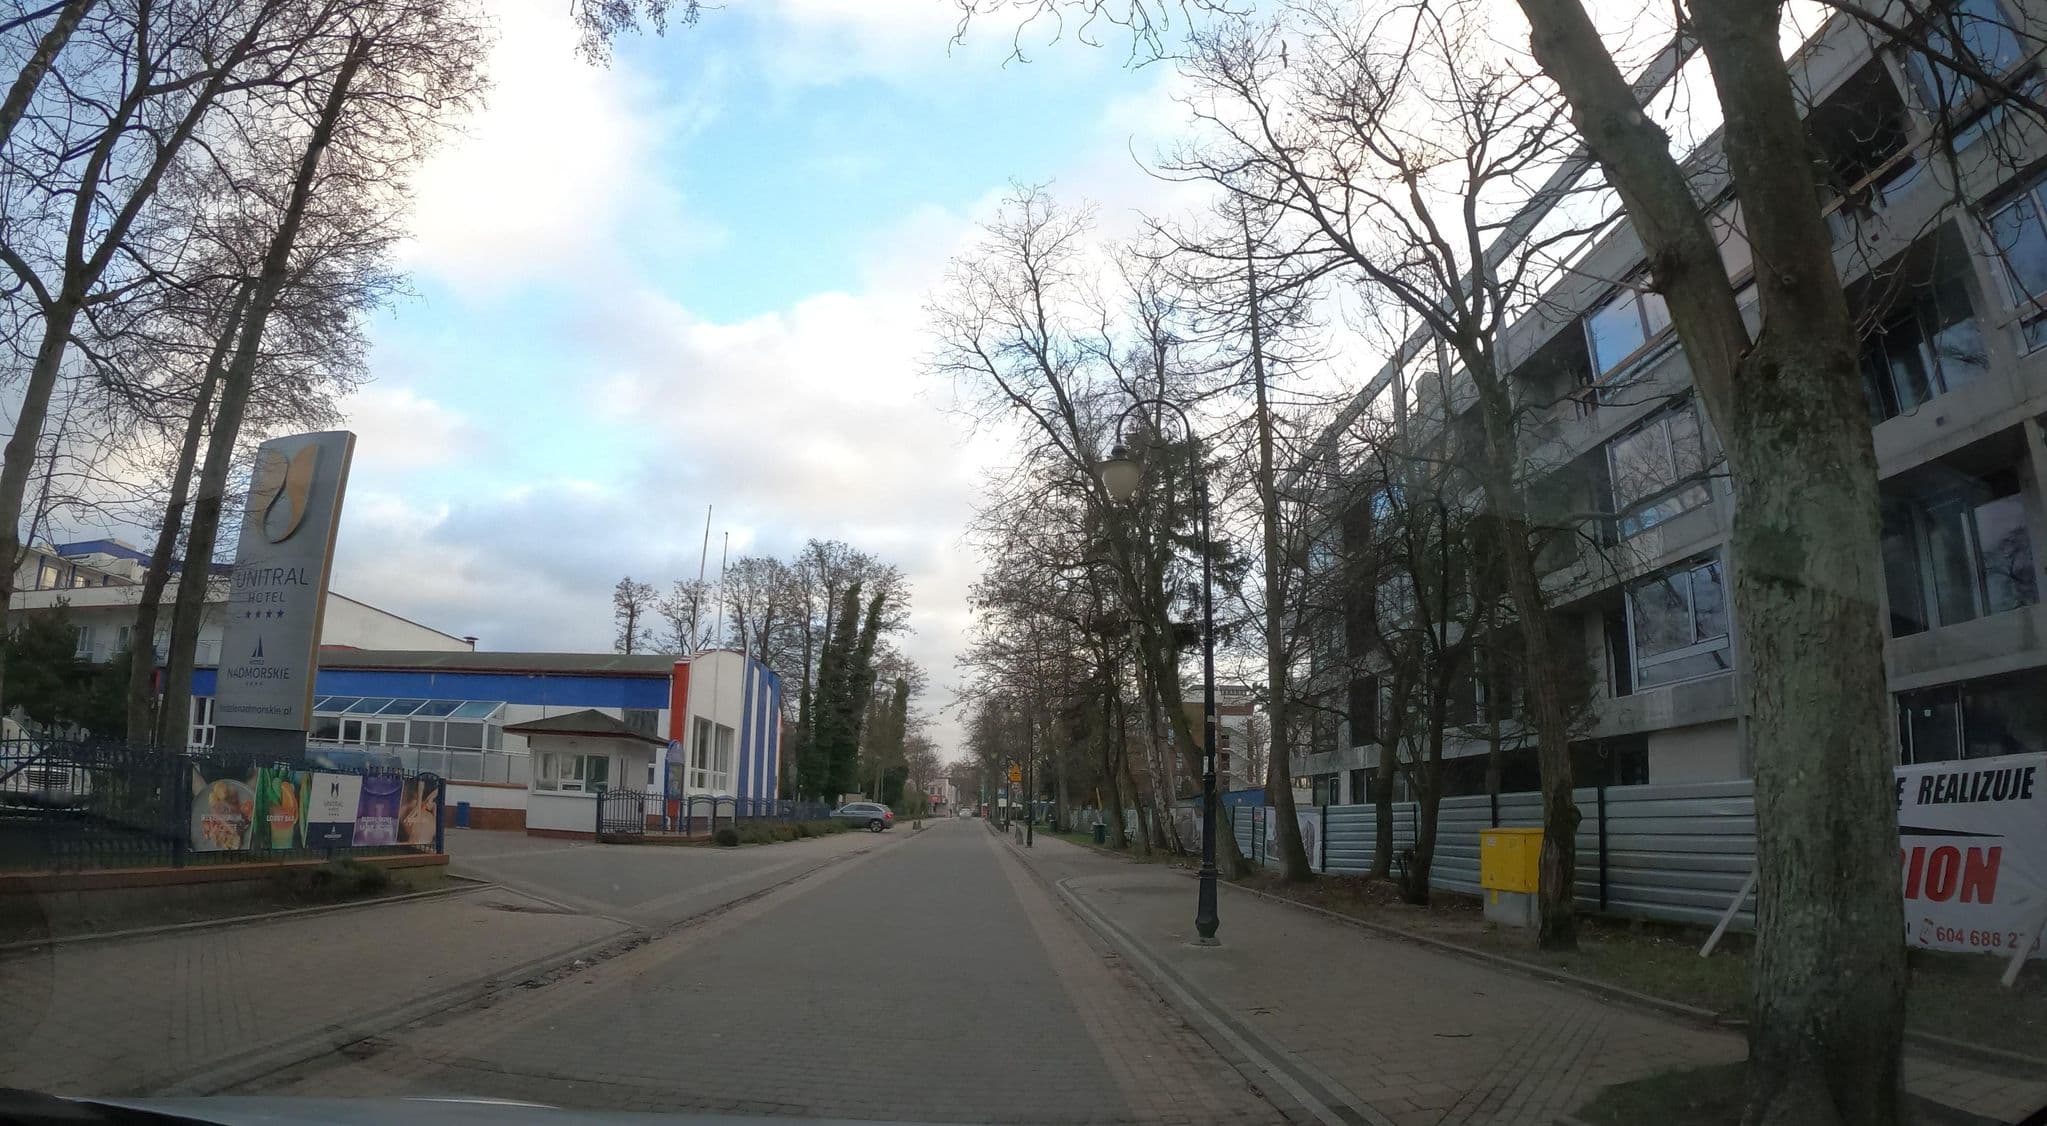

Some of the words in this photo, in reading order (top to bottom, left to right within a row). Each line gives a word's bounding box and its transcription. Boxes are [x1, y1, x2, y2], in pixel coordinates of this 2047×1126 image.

[236, 566, 309, 588] UNITRAL
[247, 590, 286, 604] HOTEL
[226, 666, 291, 680] NADMORSKIE
[1917, 766, 2037, 805] REALIZUJE
[1900, 845, 2003, 905] ION
[1936, 926, 1964, 945] 604
[1969, 929, 2001, 948] 688
